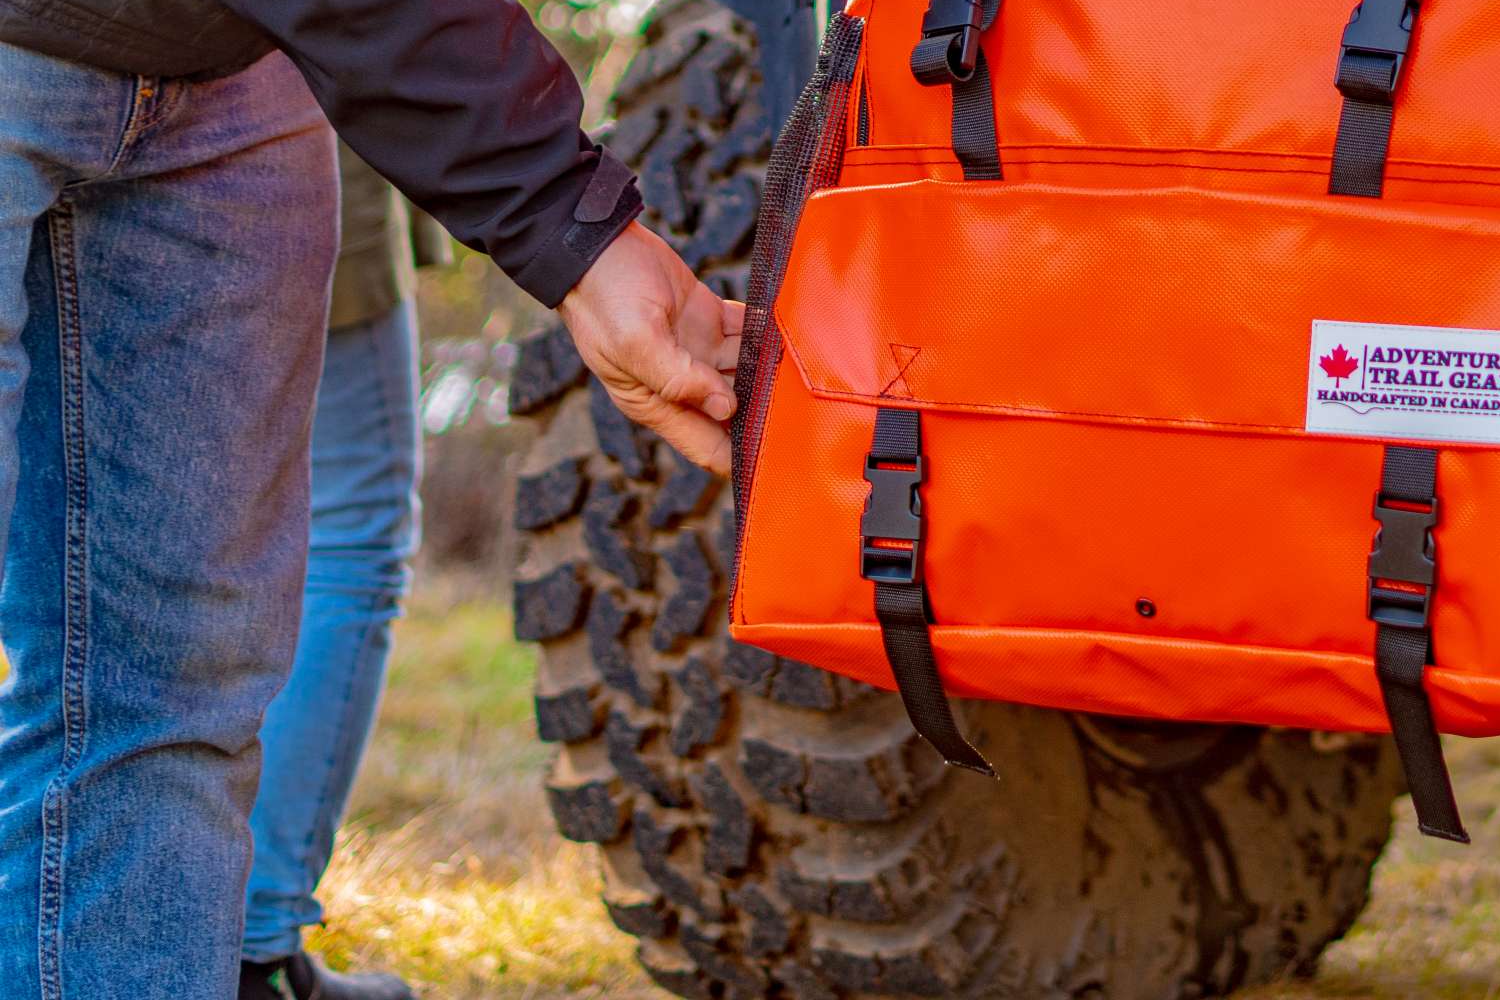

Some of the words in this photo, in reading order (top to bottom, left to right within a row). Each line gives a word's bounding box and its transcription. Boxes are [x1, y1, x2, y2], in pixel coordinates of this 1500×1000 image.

[1369, 366, 1444, 387] TRAIL
[1316, 389, 1428, 407] HANDCRAFTED
[1430, 397, 1447, 408] IN
